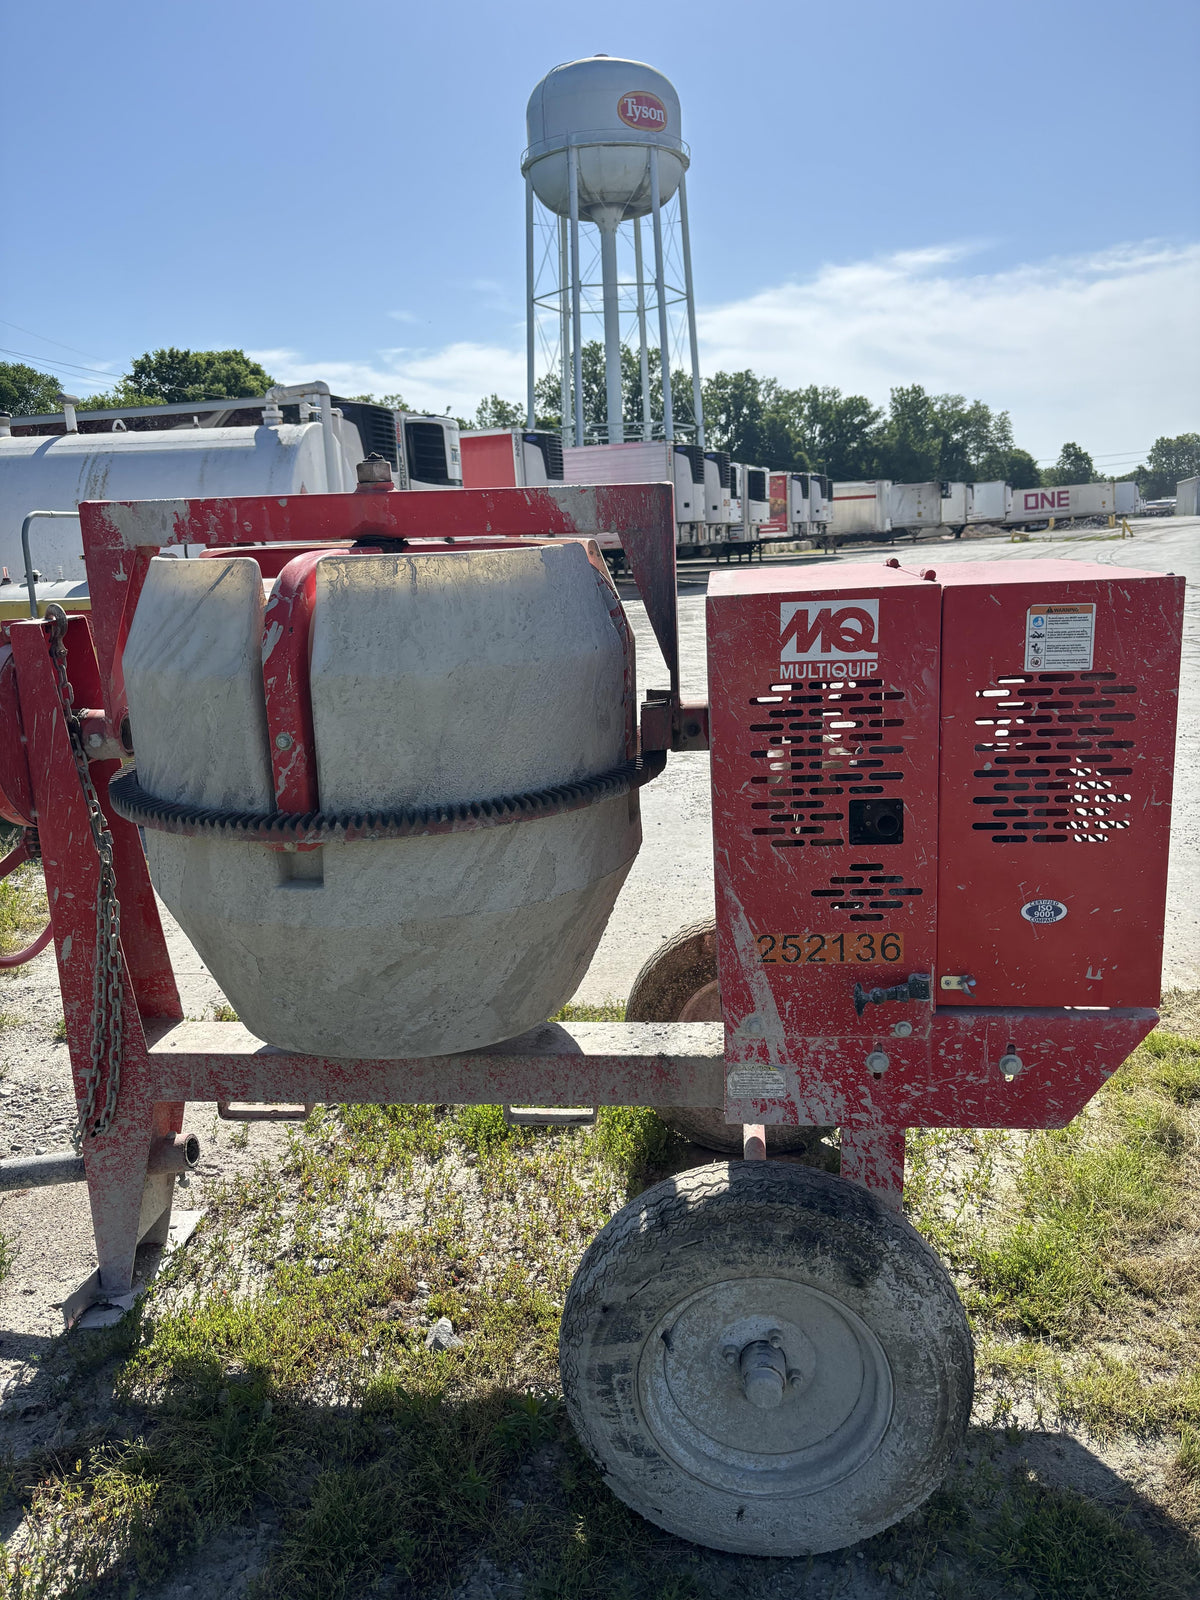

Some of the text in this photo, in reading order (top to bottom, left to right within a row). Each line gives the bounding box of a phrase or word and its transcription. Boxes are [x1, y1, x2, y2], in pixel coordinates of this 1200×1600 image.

[623, 98, 665, 122] Tyson
[1024, 490, 1069, 510] ONE
[779, 606, 878, 654] MQ
[780, 662, 878, 679] MULTIQUIP
[757, 932, 901, 963] 252136
